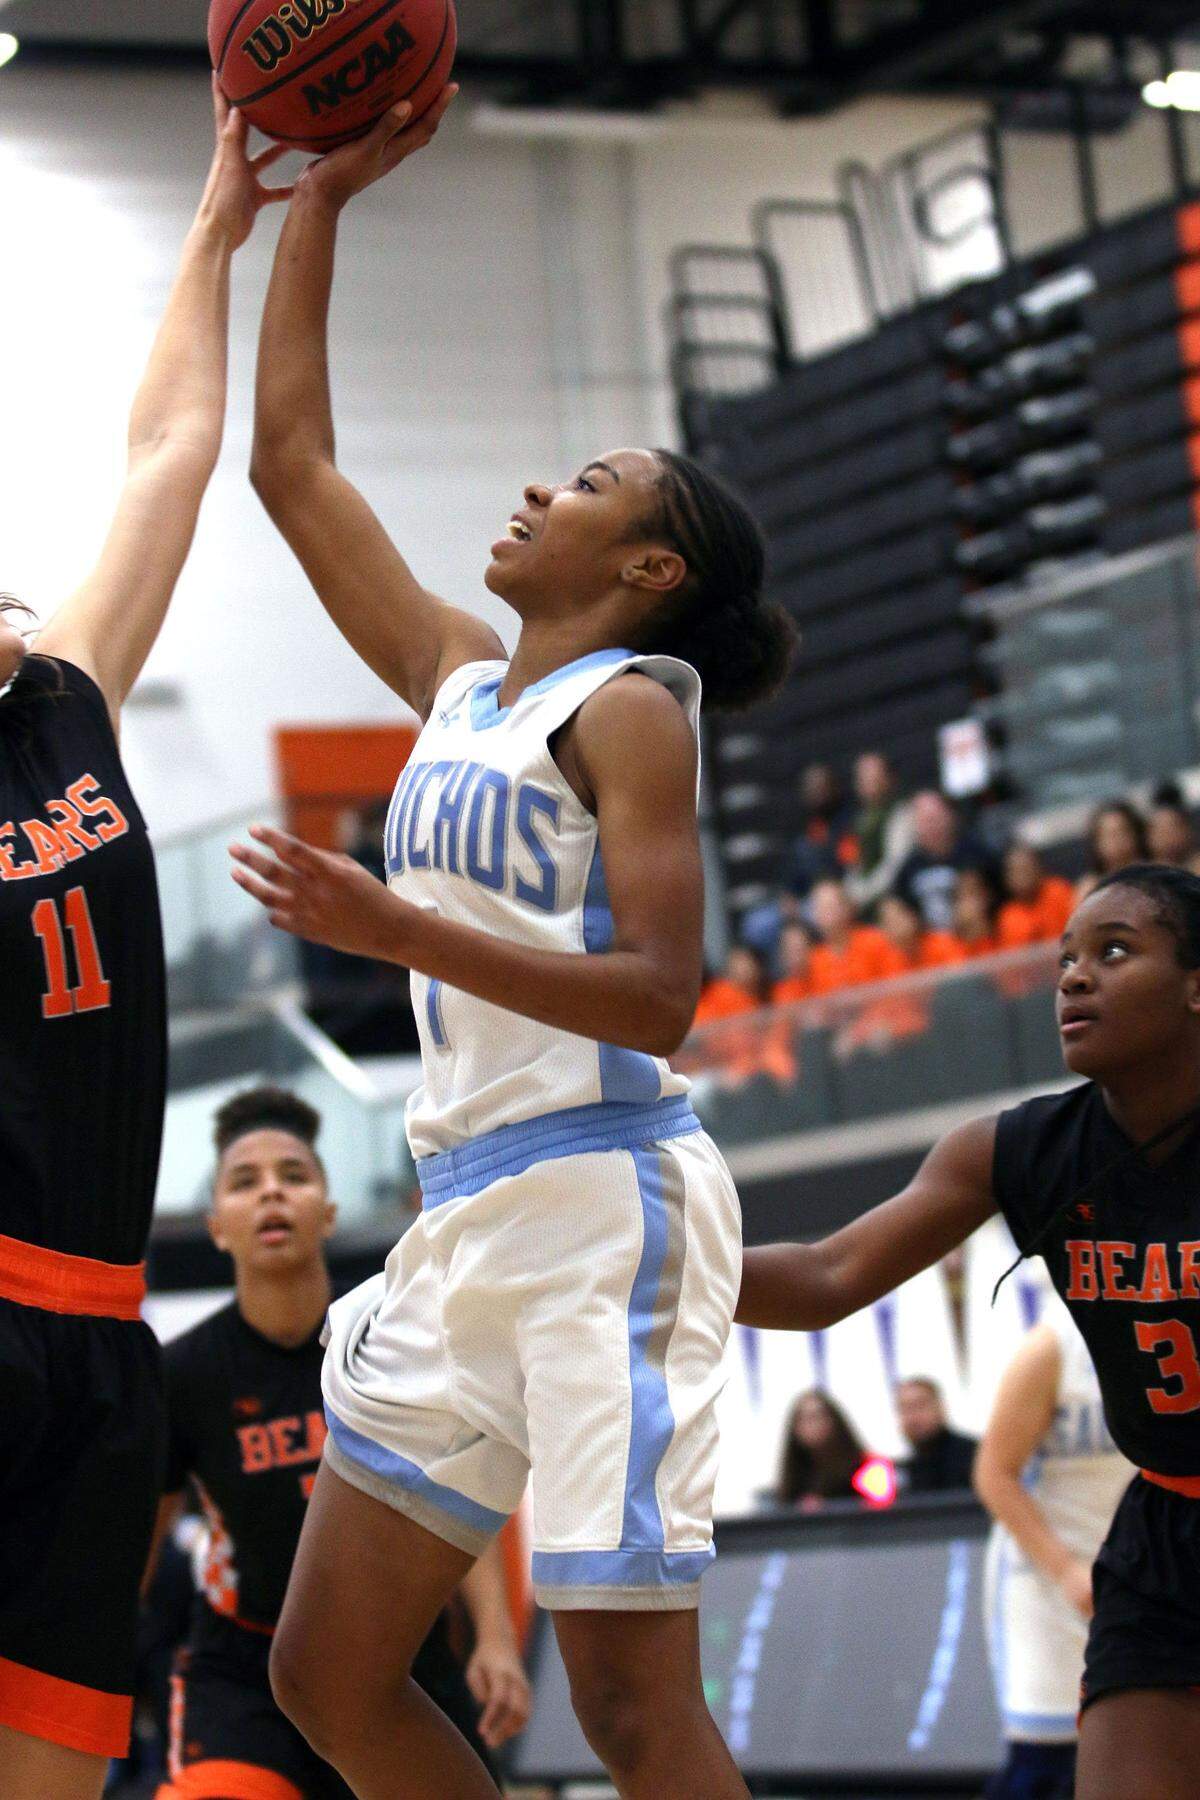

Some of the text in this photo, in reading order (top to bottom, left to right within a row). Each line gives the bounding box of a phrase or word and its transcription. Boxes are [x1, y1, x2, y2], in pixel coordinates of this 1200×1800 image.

[302, 19, 416, 115] NCAA
[31, 886, 111, 1019] 11
[1133, 1318, 1200, 1414] 3
